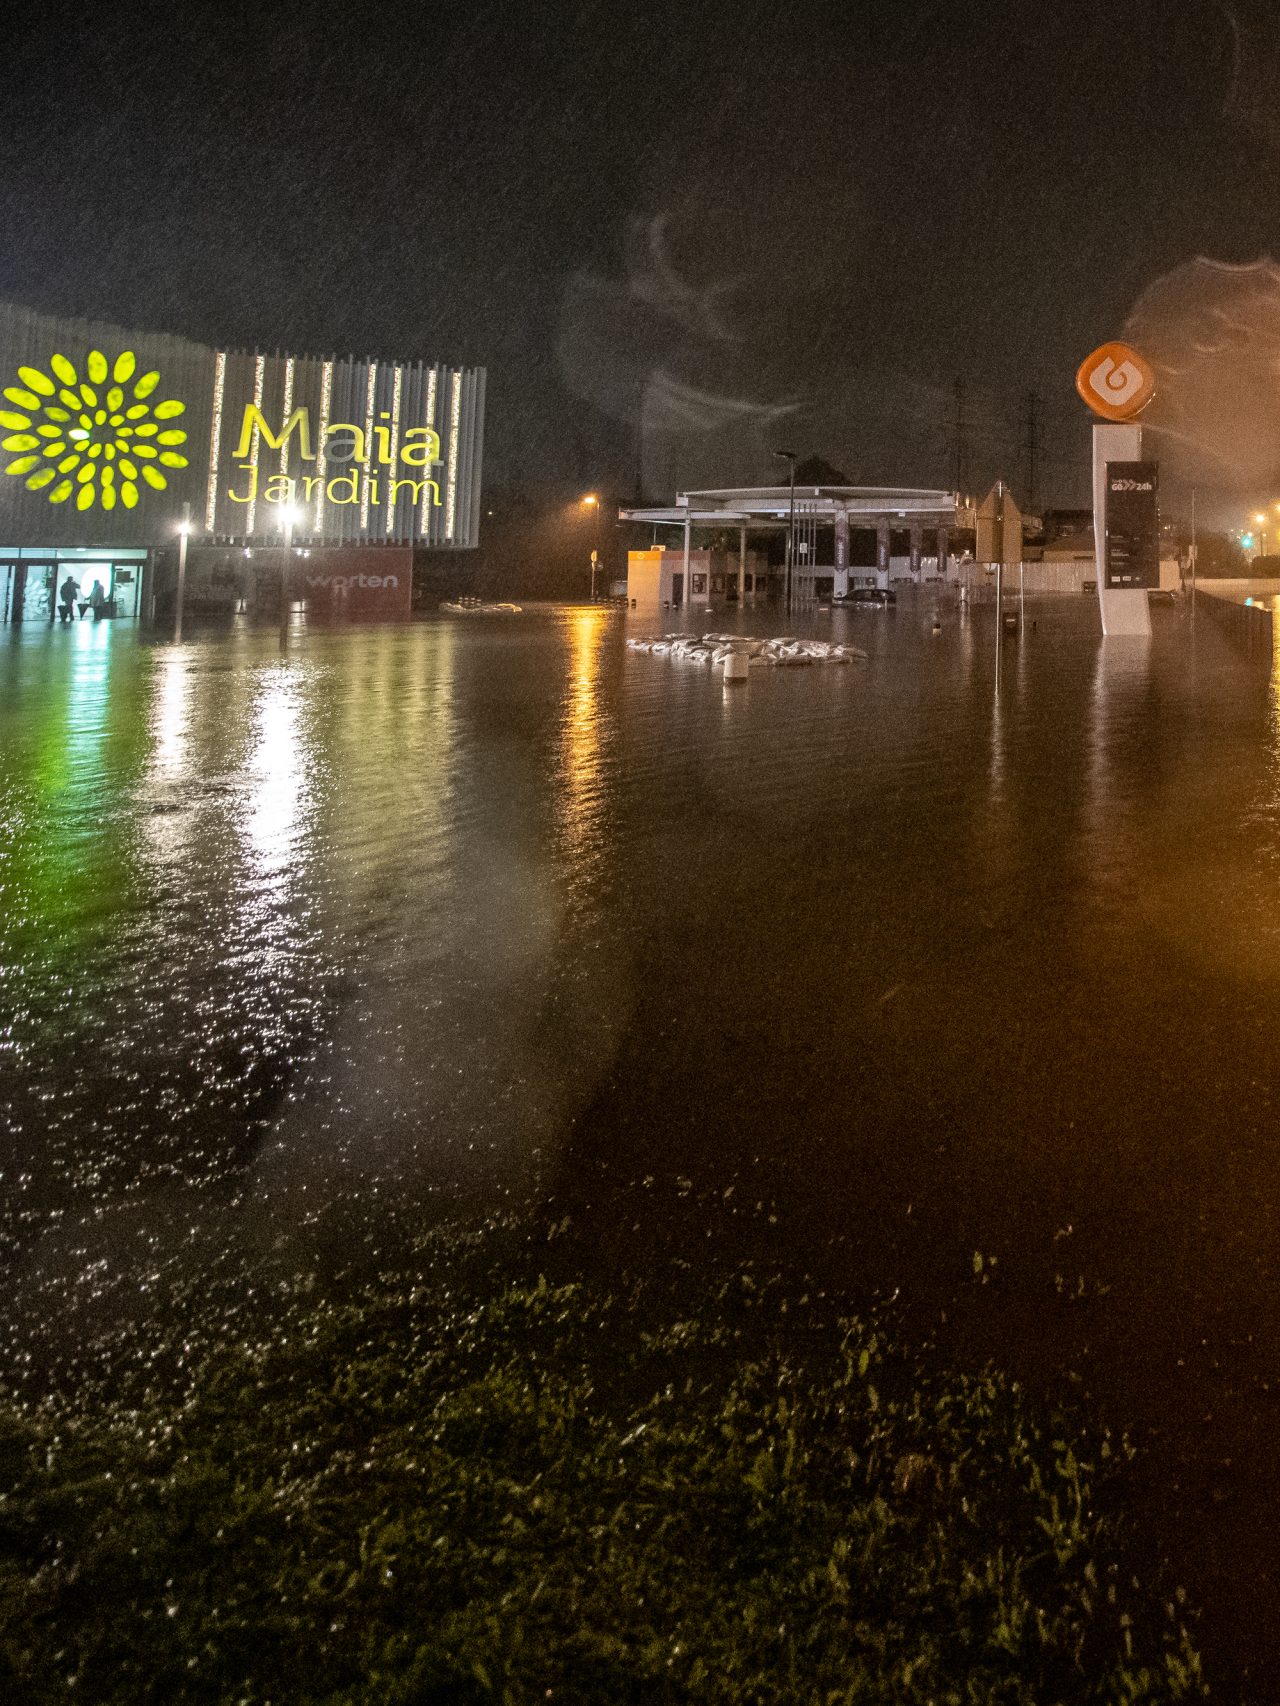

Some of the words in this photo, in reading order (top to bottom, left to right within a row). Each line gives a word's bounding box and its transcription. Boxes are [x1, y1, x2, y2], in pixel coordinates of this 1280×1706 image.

[232, 404, 444, 466] Maia
[228, 464, 442, 506] Jardim
[307, 573, 398, 588] worten
